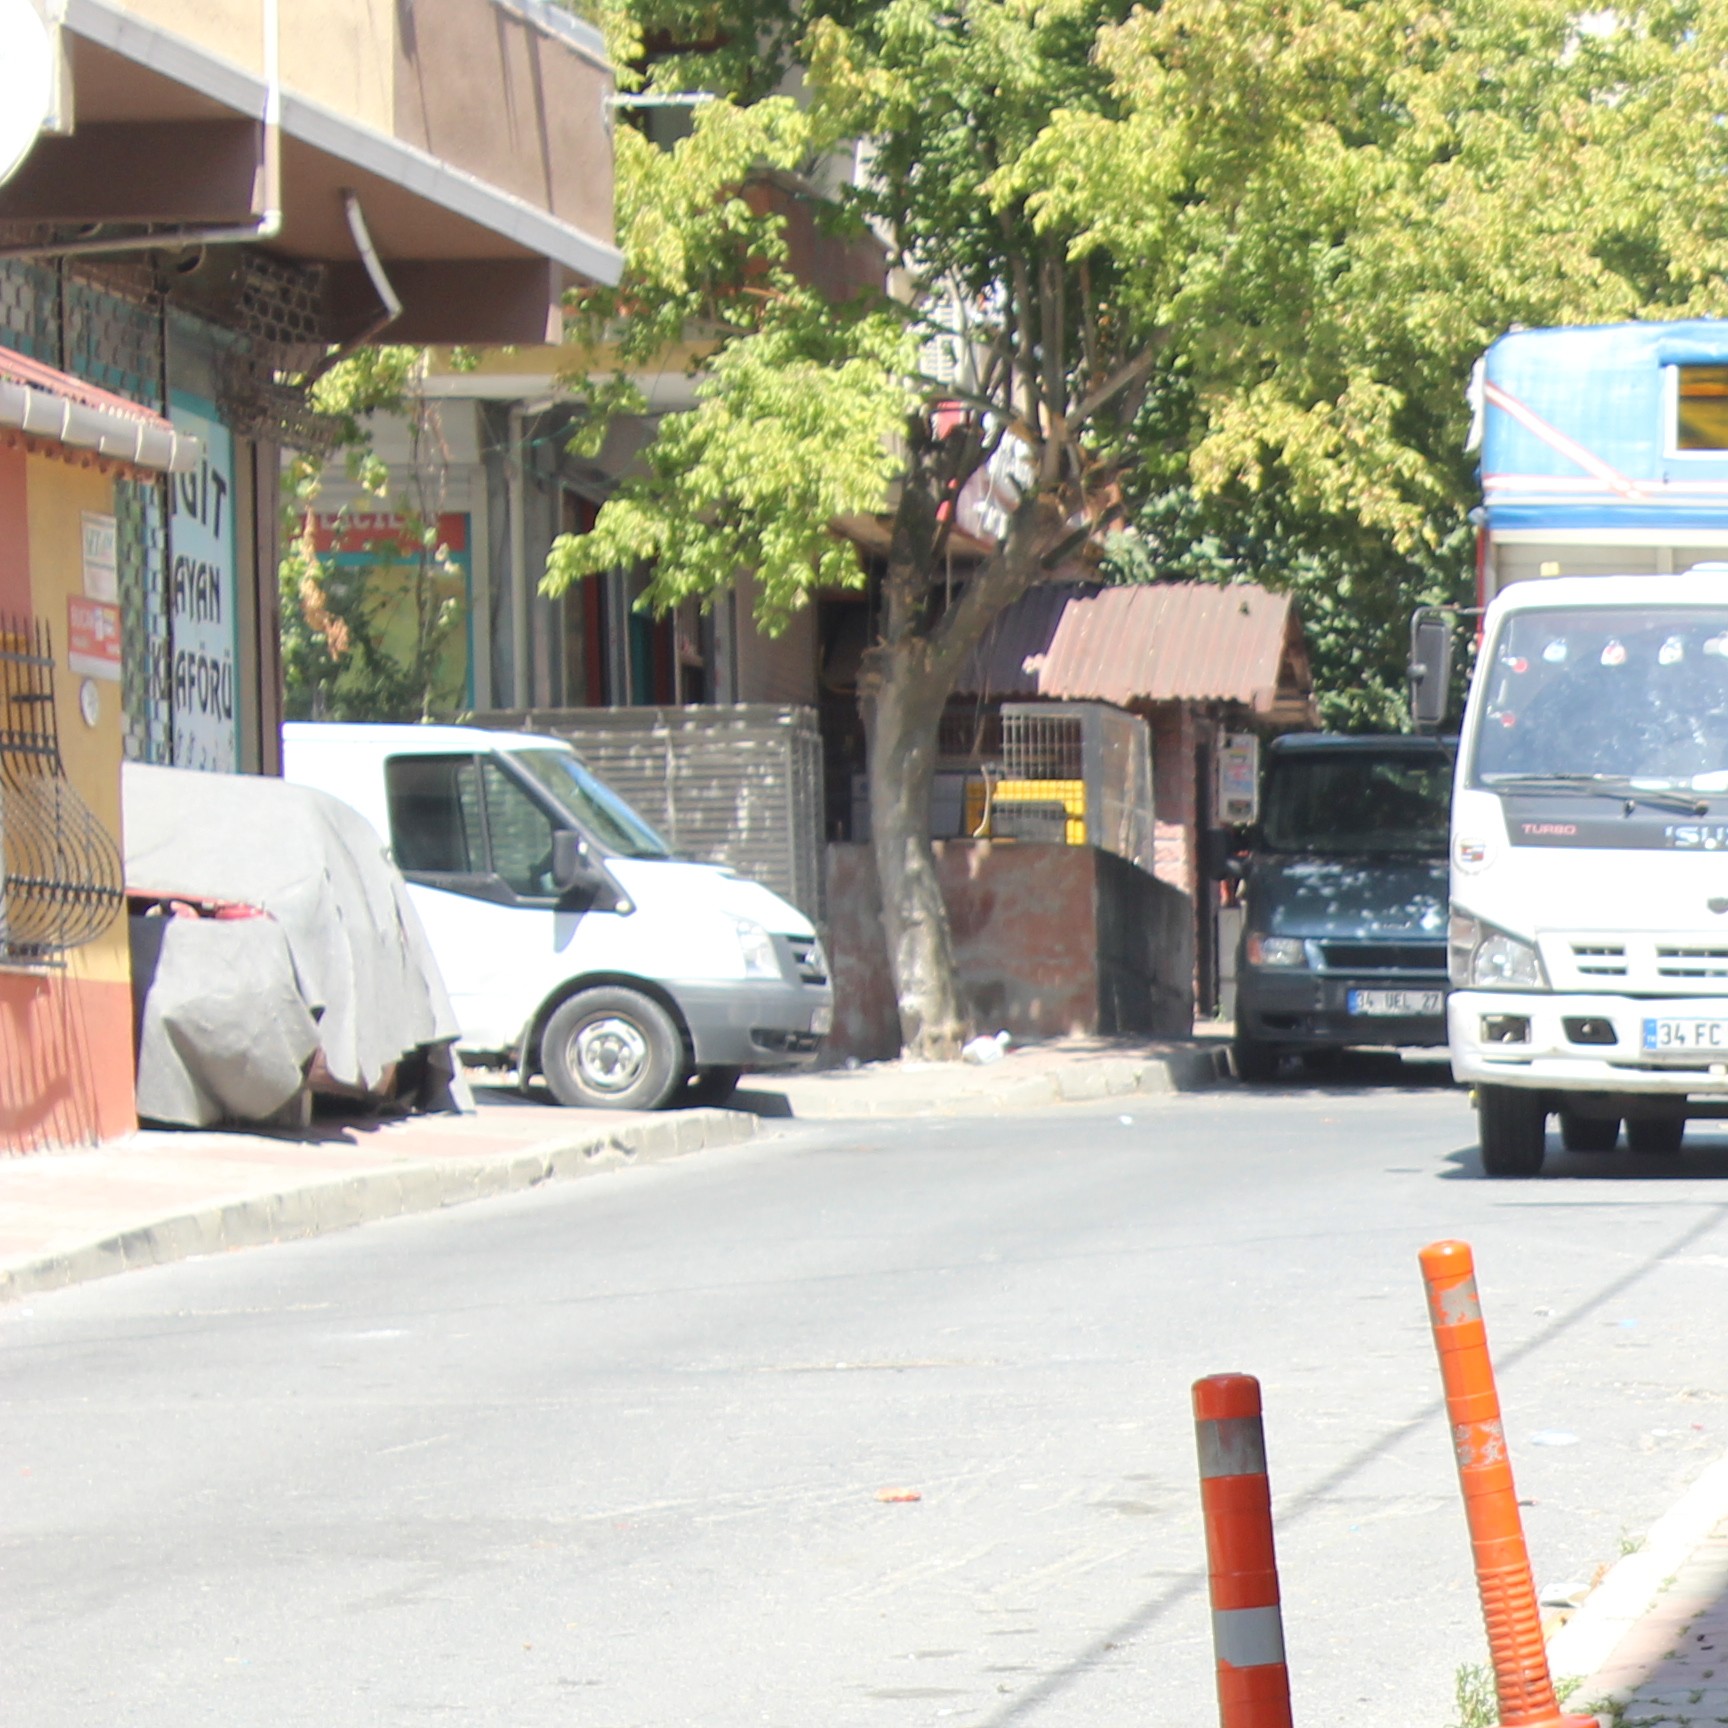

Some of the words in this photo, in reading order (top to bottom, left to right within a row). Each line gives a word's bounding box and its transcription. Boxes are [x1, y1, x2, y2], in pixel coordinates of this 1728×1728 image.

[172, 555, 221, 624] AYAN
[151, 640, 232, 722] KAFÖRÜ
[1521, 823, 1577, 836] TURBO
[1659, 1023, 1686, 1046] 34
[1694, 1023, 1721, 1046] FC
